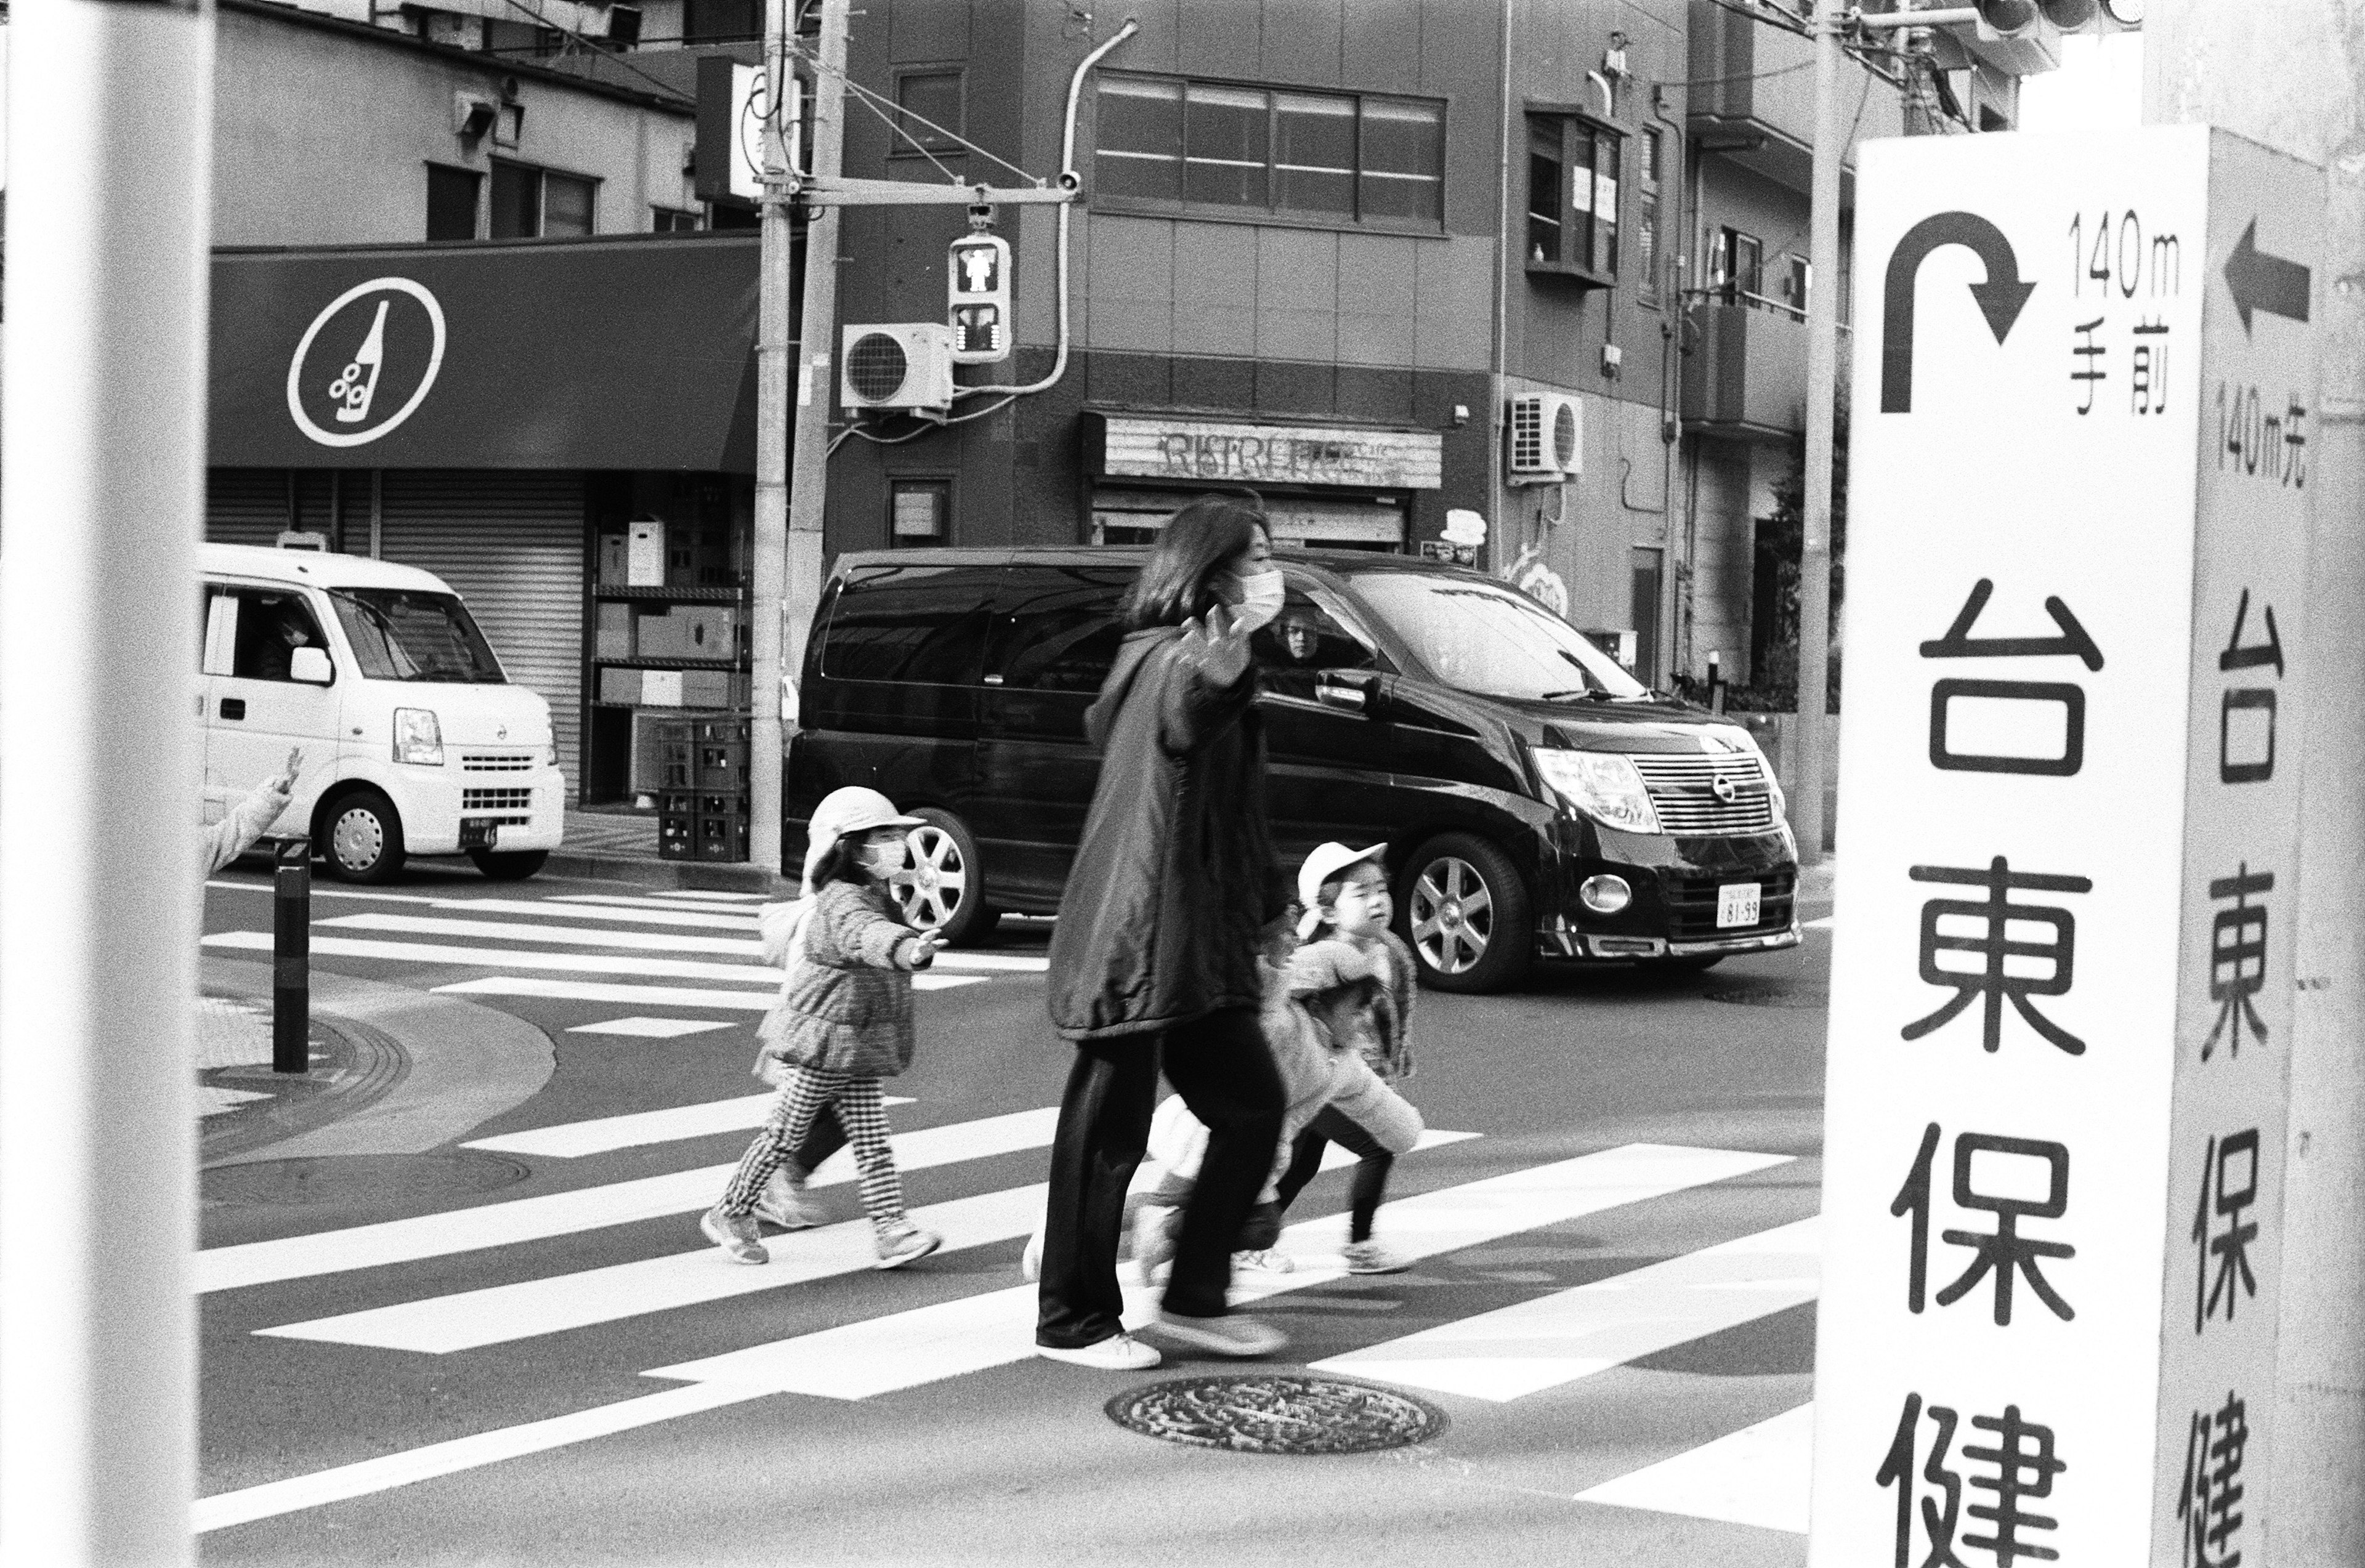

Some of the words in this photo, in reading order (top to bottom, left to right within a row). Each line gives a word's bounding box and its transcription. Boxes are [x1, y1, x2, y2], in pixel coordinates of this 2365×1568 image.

[2068, 209, 2180, 299] 140m
[2070, 313, 2170, 416] 手前
[2217, 379, 2306, 489] 140m先
[1875, 577, 2105, 1568] 台東保健
[2177, 587, 2284, 1568] 台東保健
